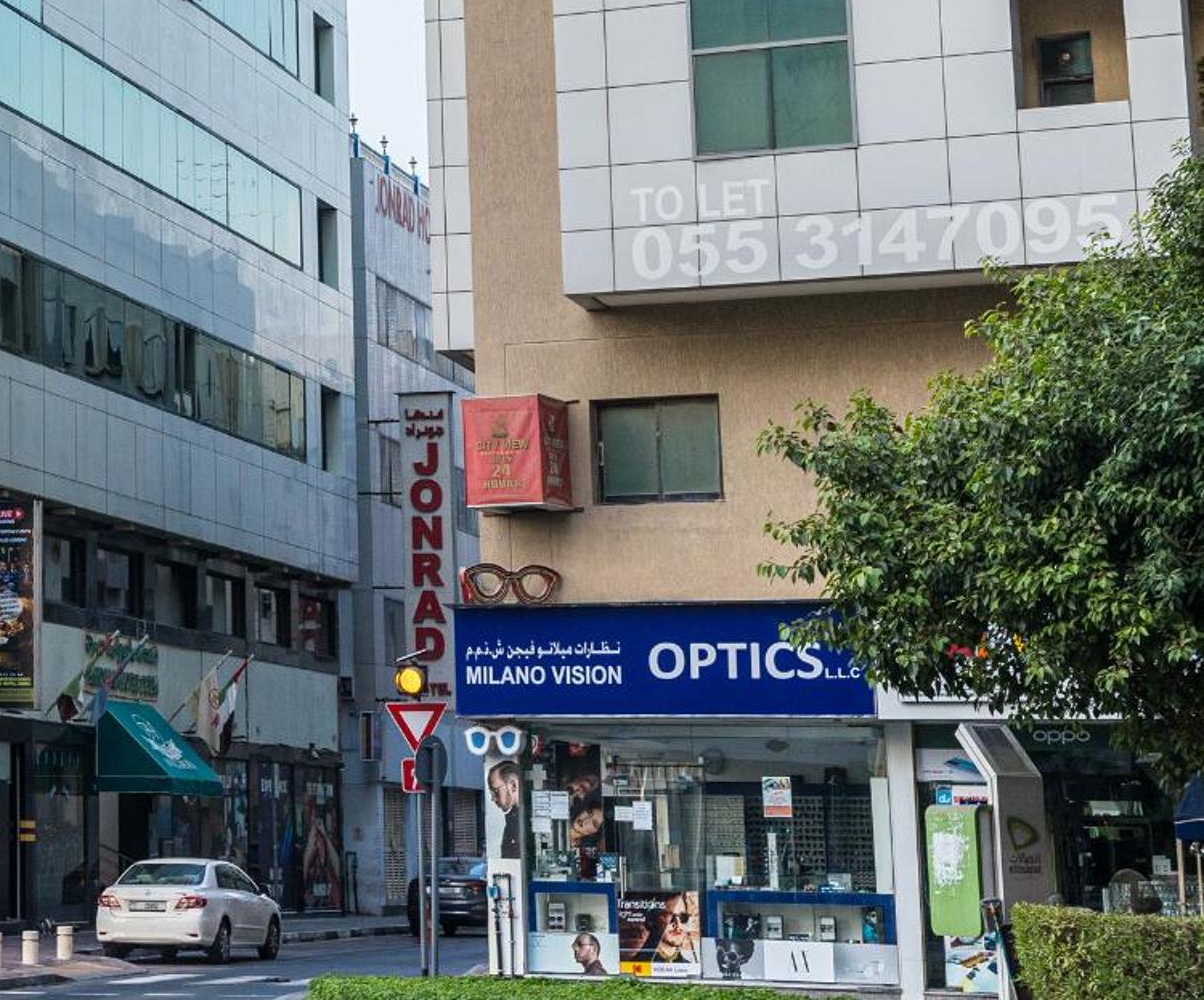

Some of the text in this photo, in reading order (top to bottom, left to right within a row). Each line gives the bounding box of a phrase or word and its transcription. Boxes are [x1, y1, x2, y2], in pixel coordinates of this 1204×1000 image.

[375, 173, 415, 233] JONRAD
[631, 178, 771, 221] TO LET
[631, 193, 1125, 281] 055 3147095
[409, 442, 447, 663] JONRAD
[507, 640, 535, 659] فيجن
[574, 641, 621, 659] نظارات
[648, 642, 825, 680] OPTICS
[466, 665, 622, 685] MILANO VISION
